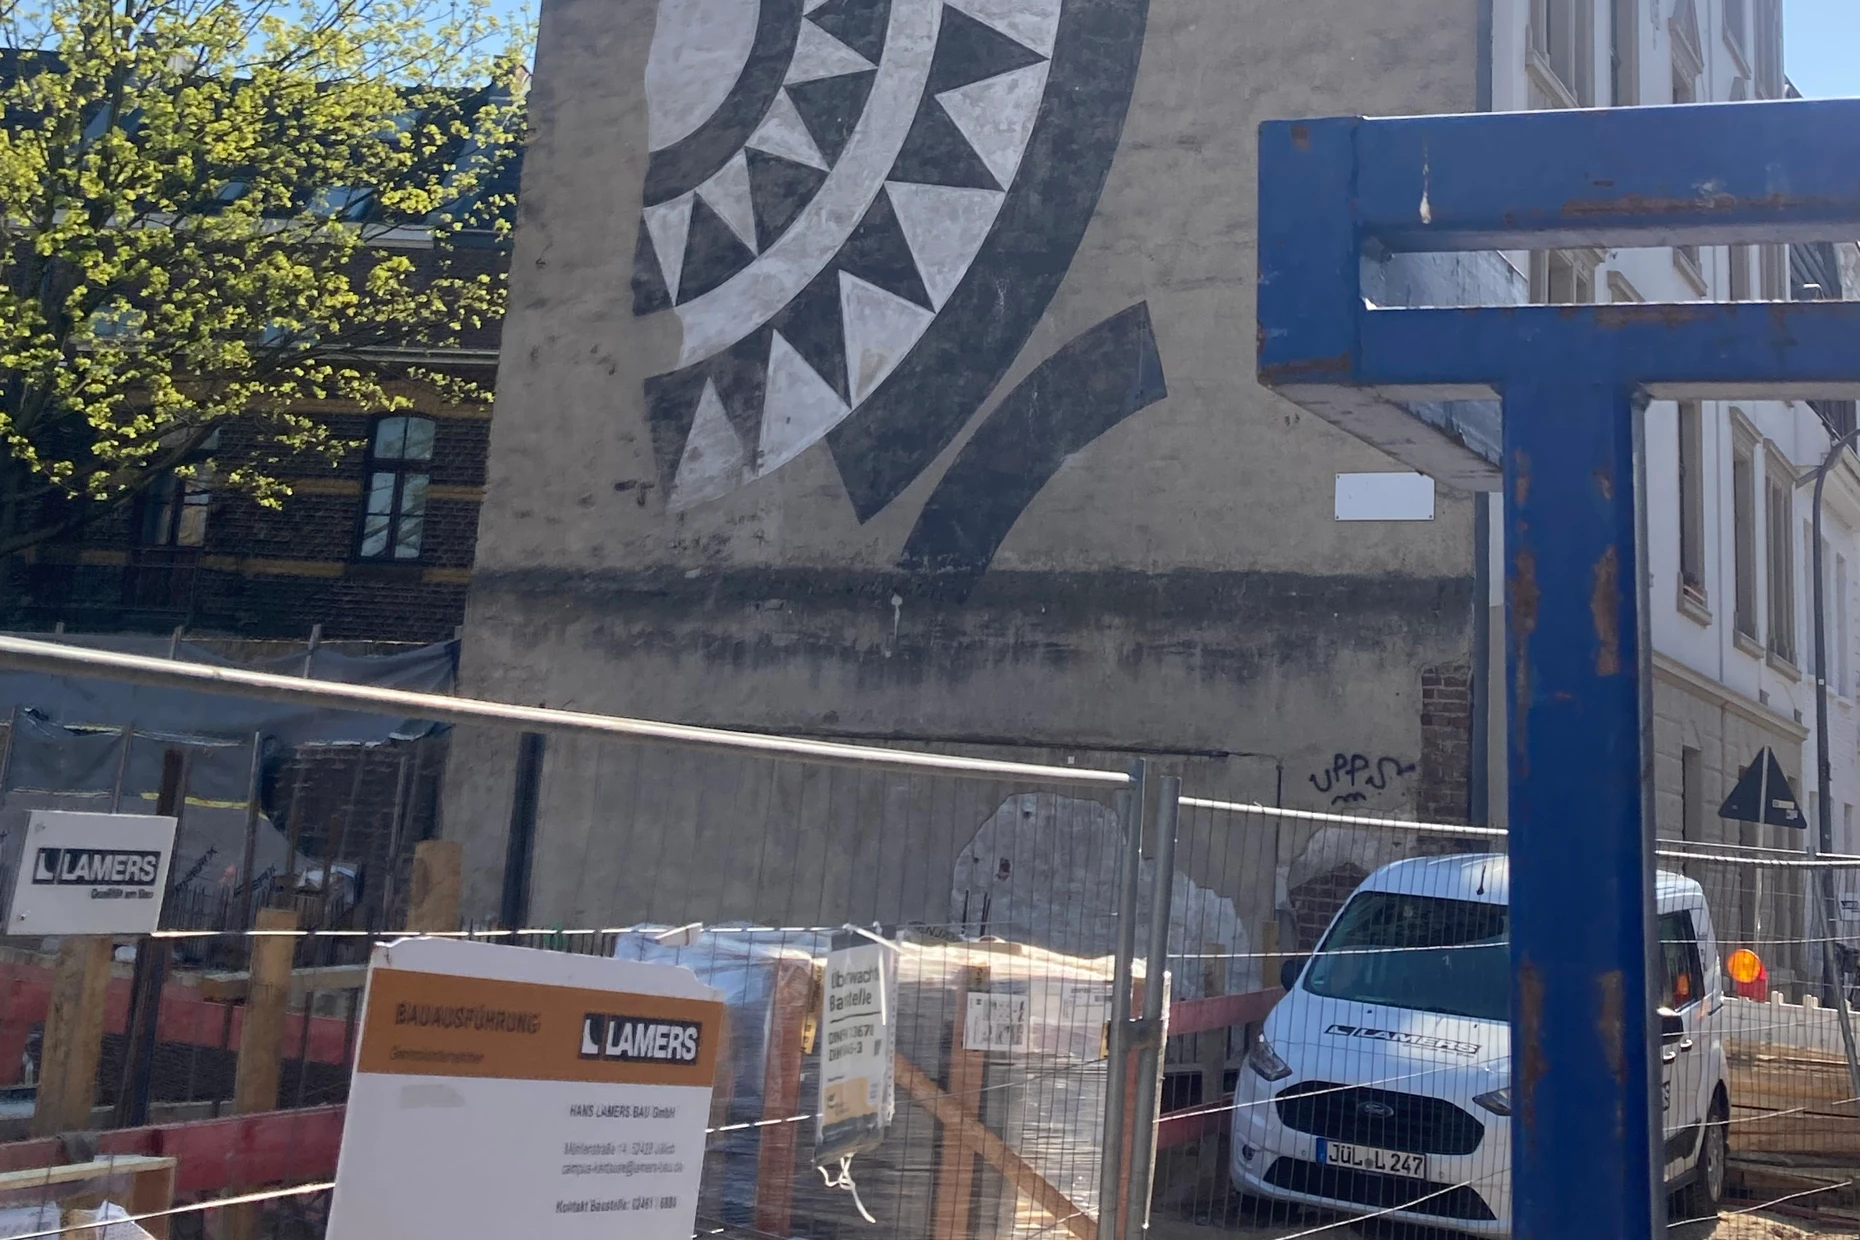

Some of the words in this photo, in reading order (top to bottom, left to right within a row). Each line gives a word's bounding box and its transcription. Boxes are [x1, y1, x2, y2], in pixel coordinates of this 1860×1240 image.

[57, 852, 158, 883] LAMERS
[394, 1002, 541, 1035] BAUAUSFÜHRUNG
[605, 1021, 698, 1061] LAMERS
[1354, 1027, 1481, 1055] LAMERS
[570, 1104, 594, 1118] HANS
[596, 1105, 631, 1118] LAMERS
[633, 1106, 650, 1118] BAU
[652, 1106, 676, 1119] GmbH
[1328, 1144, 1363, 1167] JÜL
[1375, 1151, 1386, 1170] L
[1390, 1153, 1424, 1177] 247
[556, 1200, 589, 1213] Kontakt
